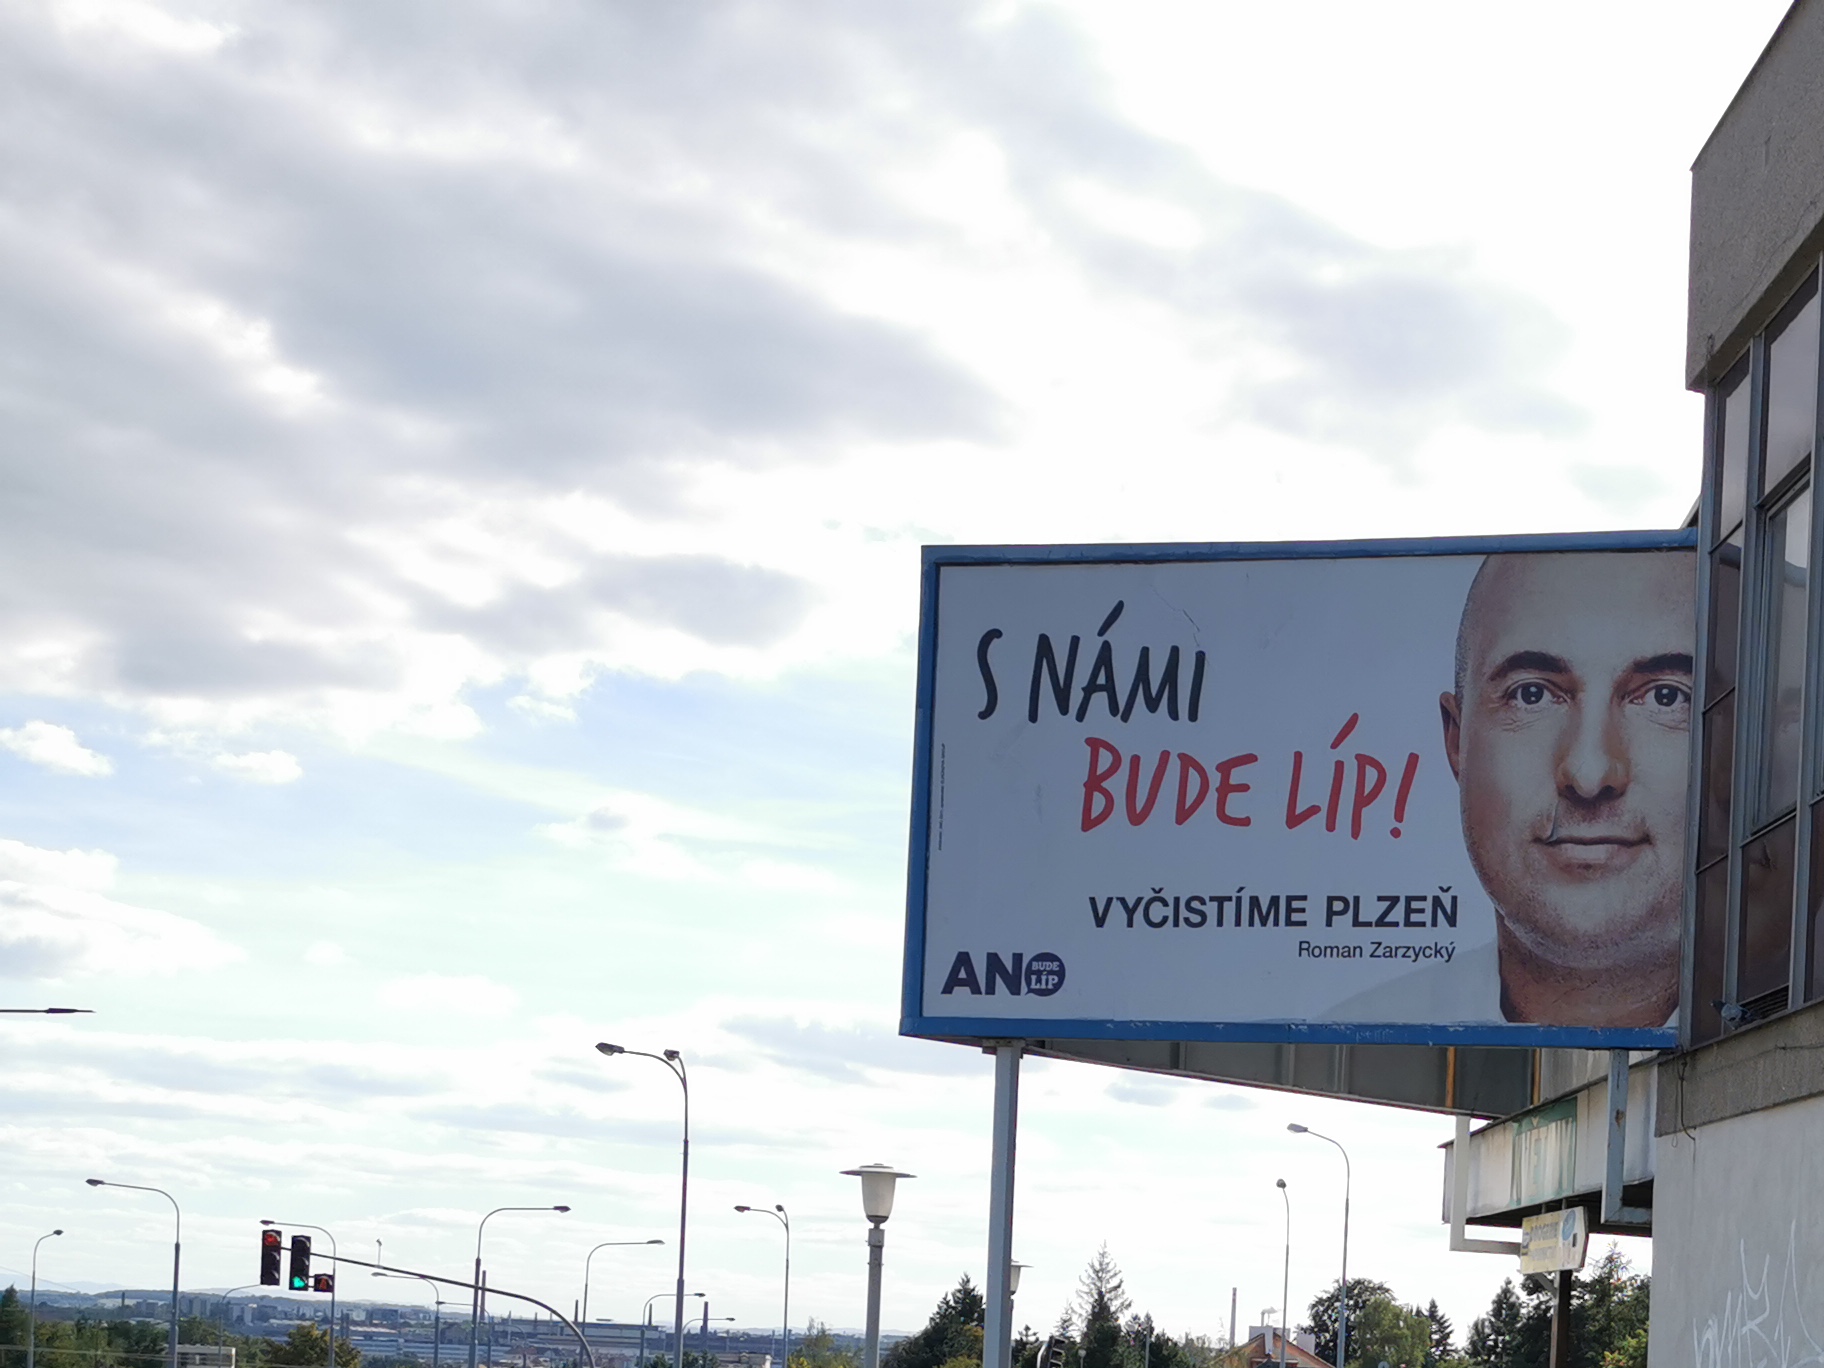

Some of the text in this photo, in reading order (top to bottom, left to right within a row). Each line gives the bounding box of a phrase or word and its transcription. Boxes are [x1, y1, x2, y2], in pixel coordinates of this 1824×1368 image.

[976, 600, 1206, 723] S NÁMI
[1081, 712, 1420, 841] BUDE LÍP!
[1089, 885, 1458, 928] VYČISTÍME PLZEŇ
[1031, 961, 1060, 971] BUDE
[1298, 941, 1456, 963] Roman Zarzycký
[1030, 971, 1059, 989] LÍP
